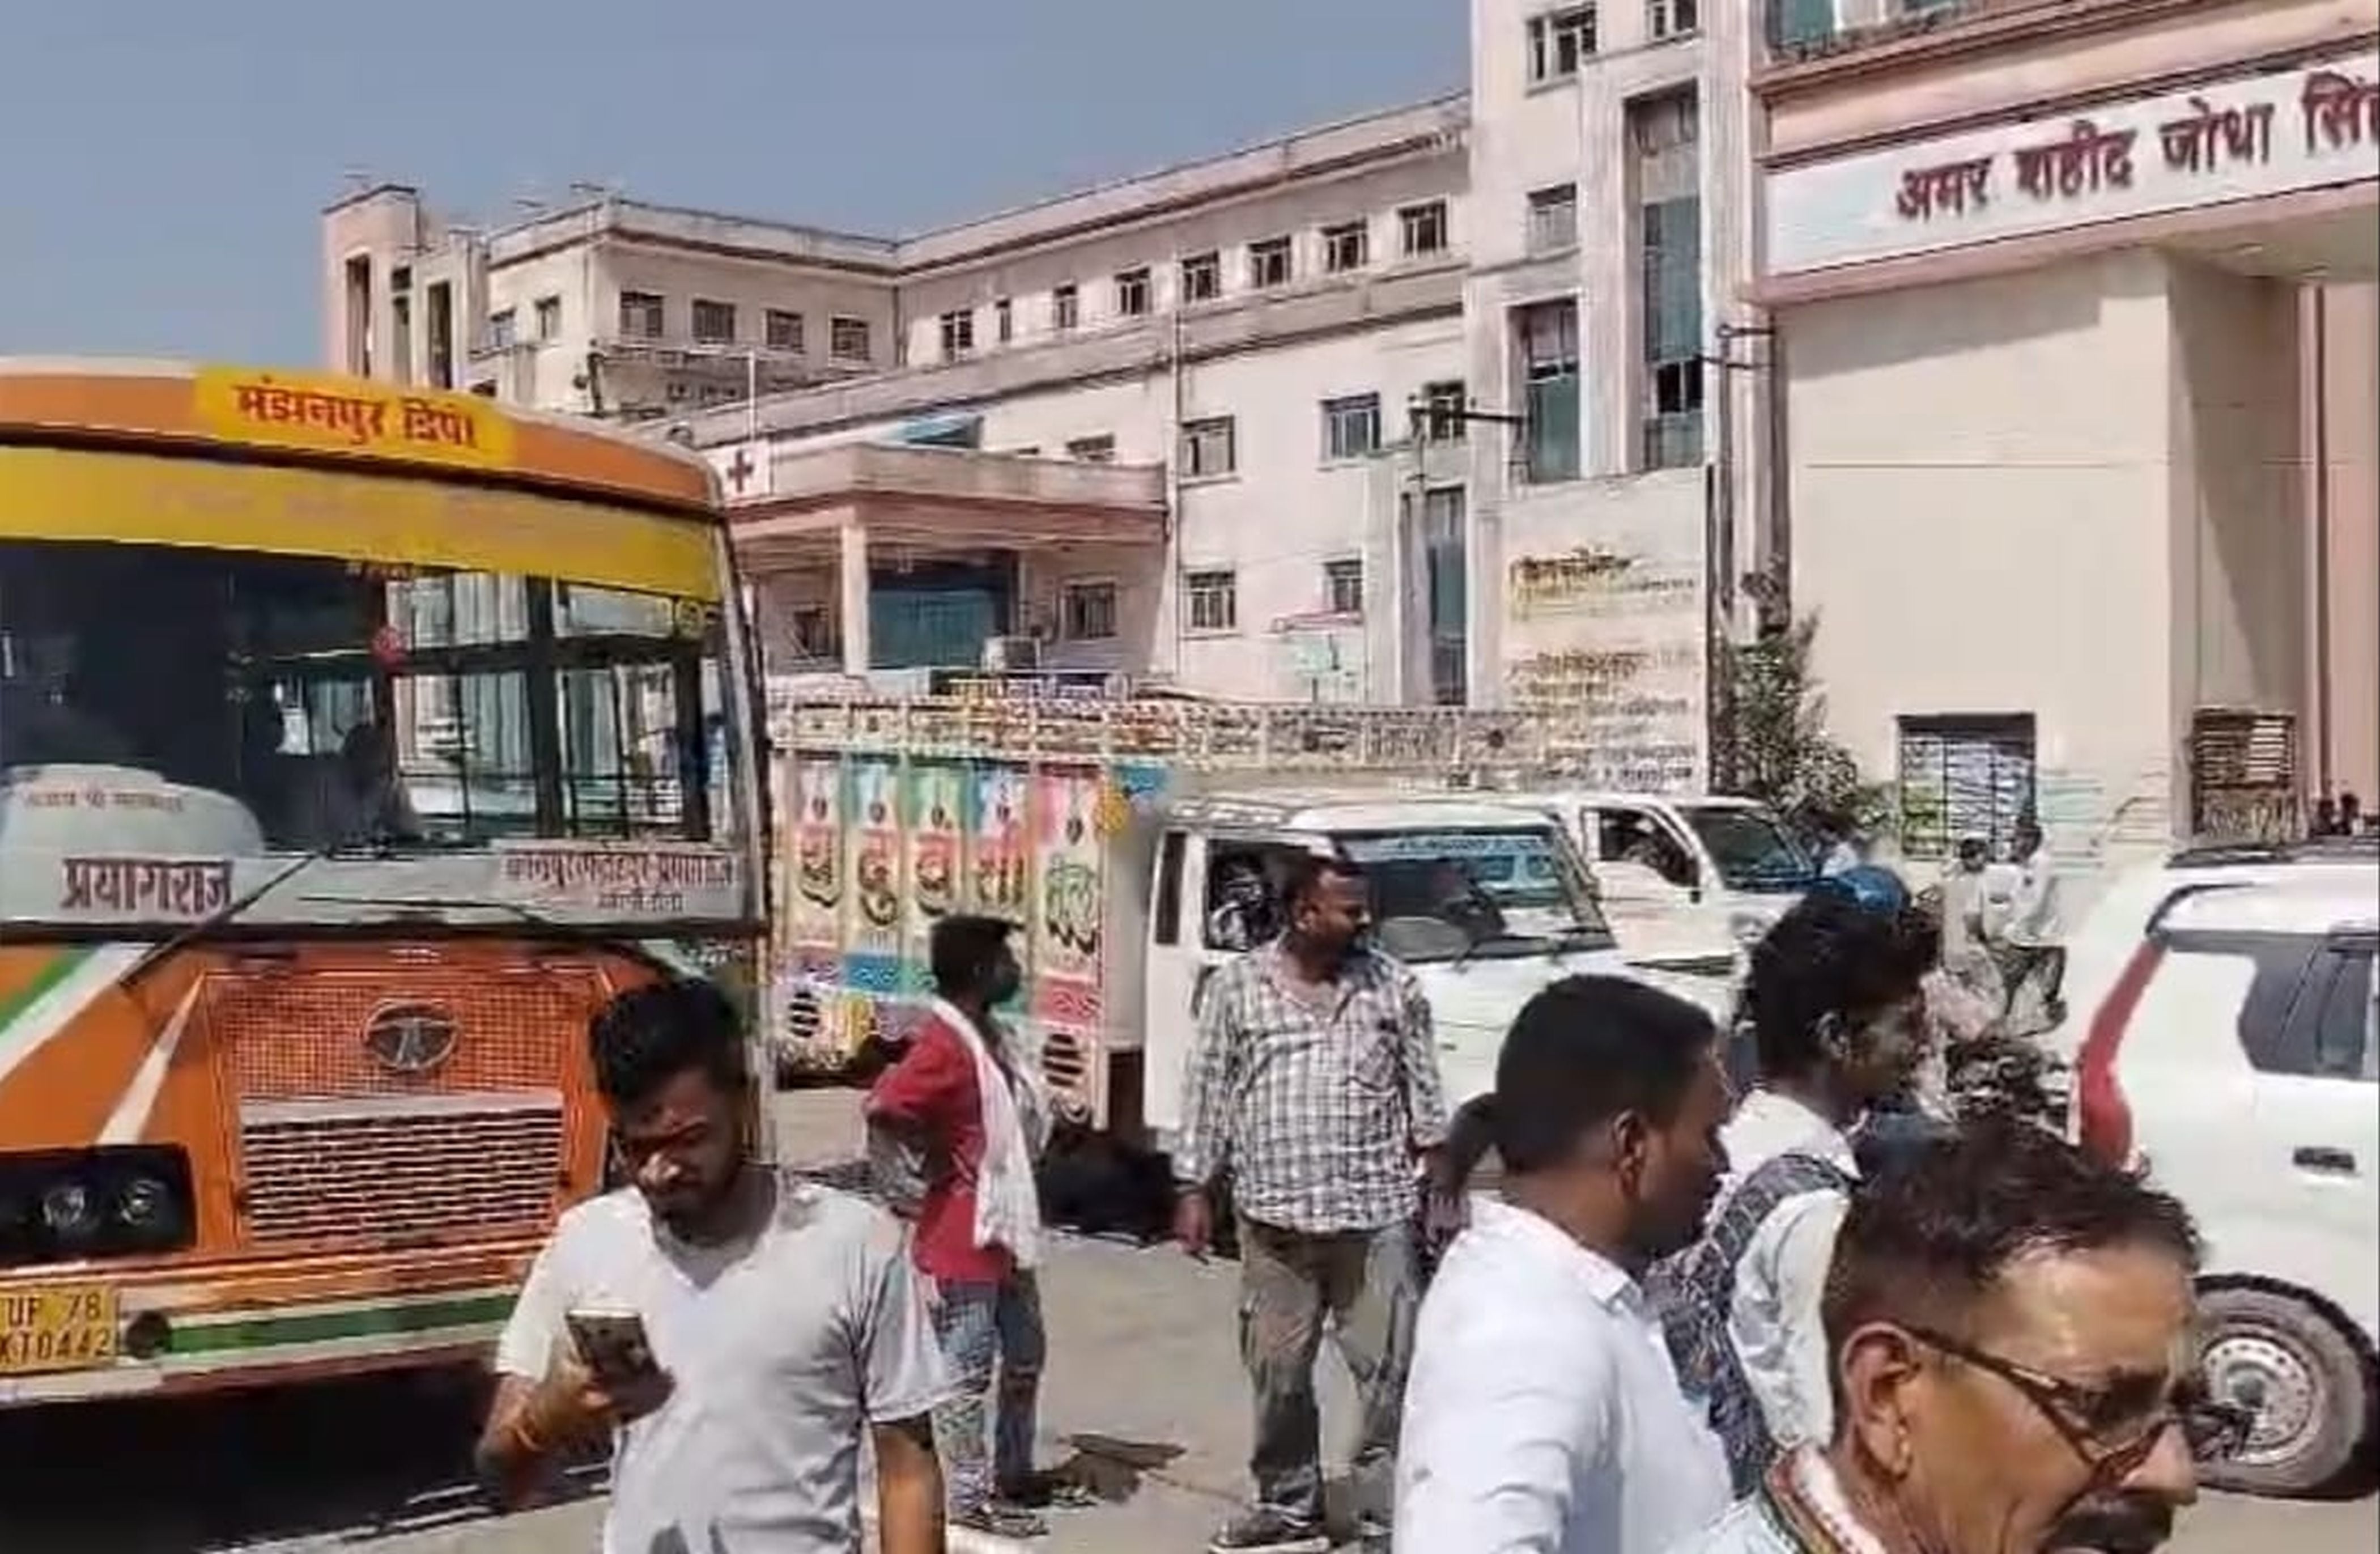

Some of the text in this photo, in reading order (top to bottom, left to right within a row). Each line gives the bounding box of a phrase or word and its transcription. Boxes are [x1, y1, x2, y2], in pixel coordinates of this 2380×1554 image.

[1896, 155, 1994, 221] अमर
[2158, 95, 2275, 172] जोधा
[59, 857, 233, 915] प्रयागराज
[66, 1292, 101, 1322] 78
